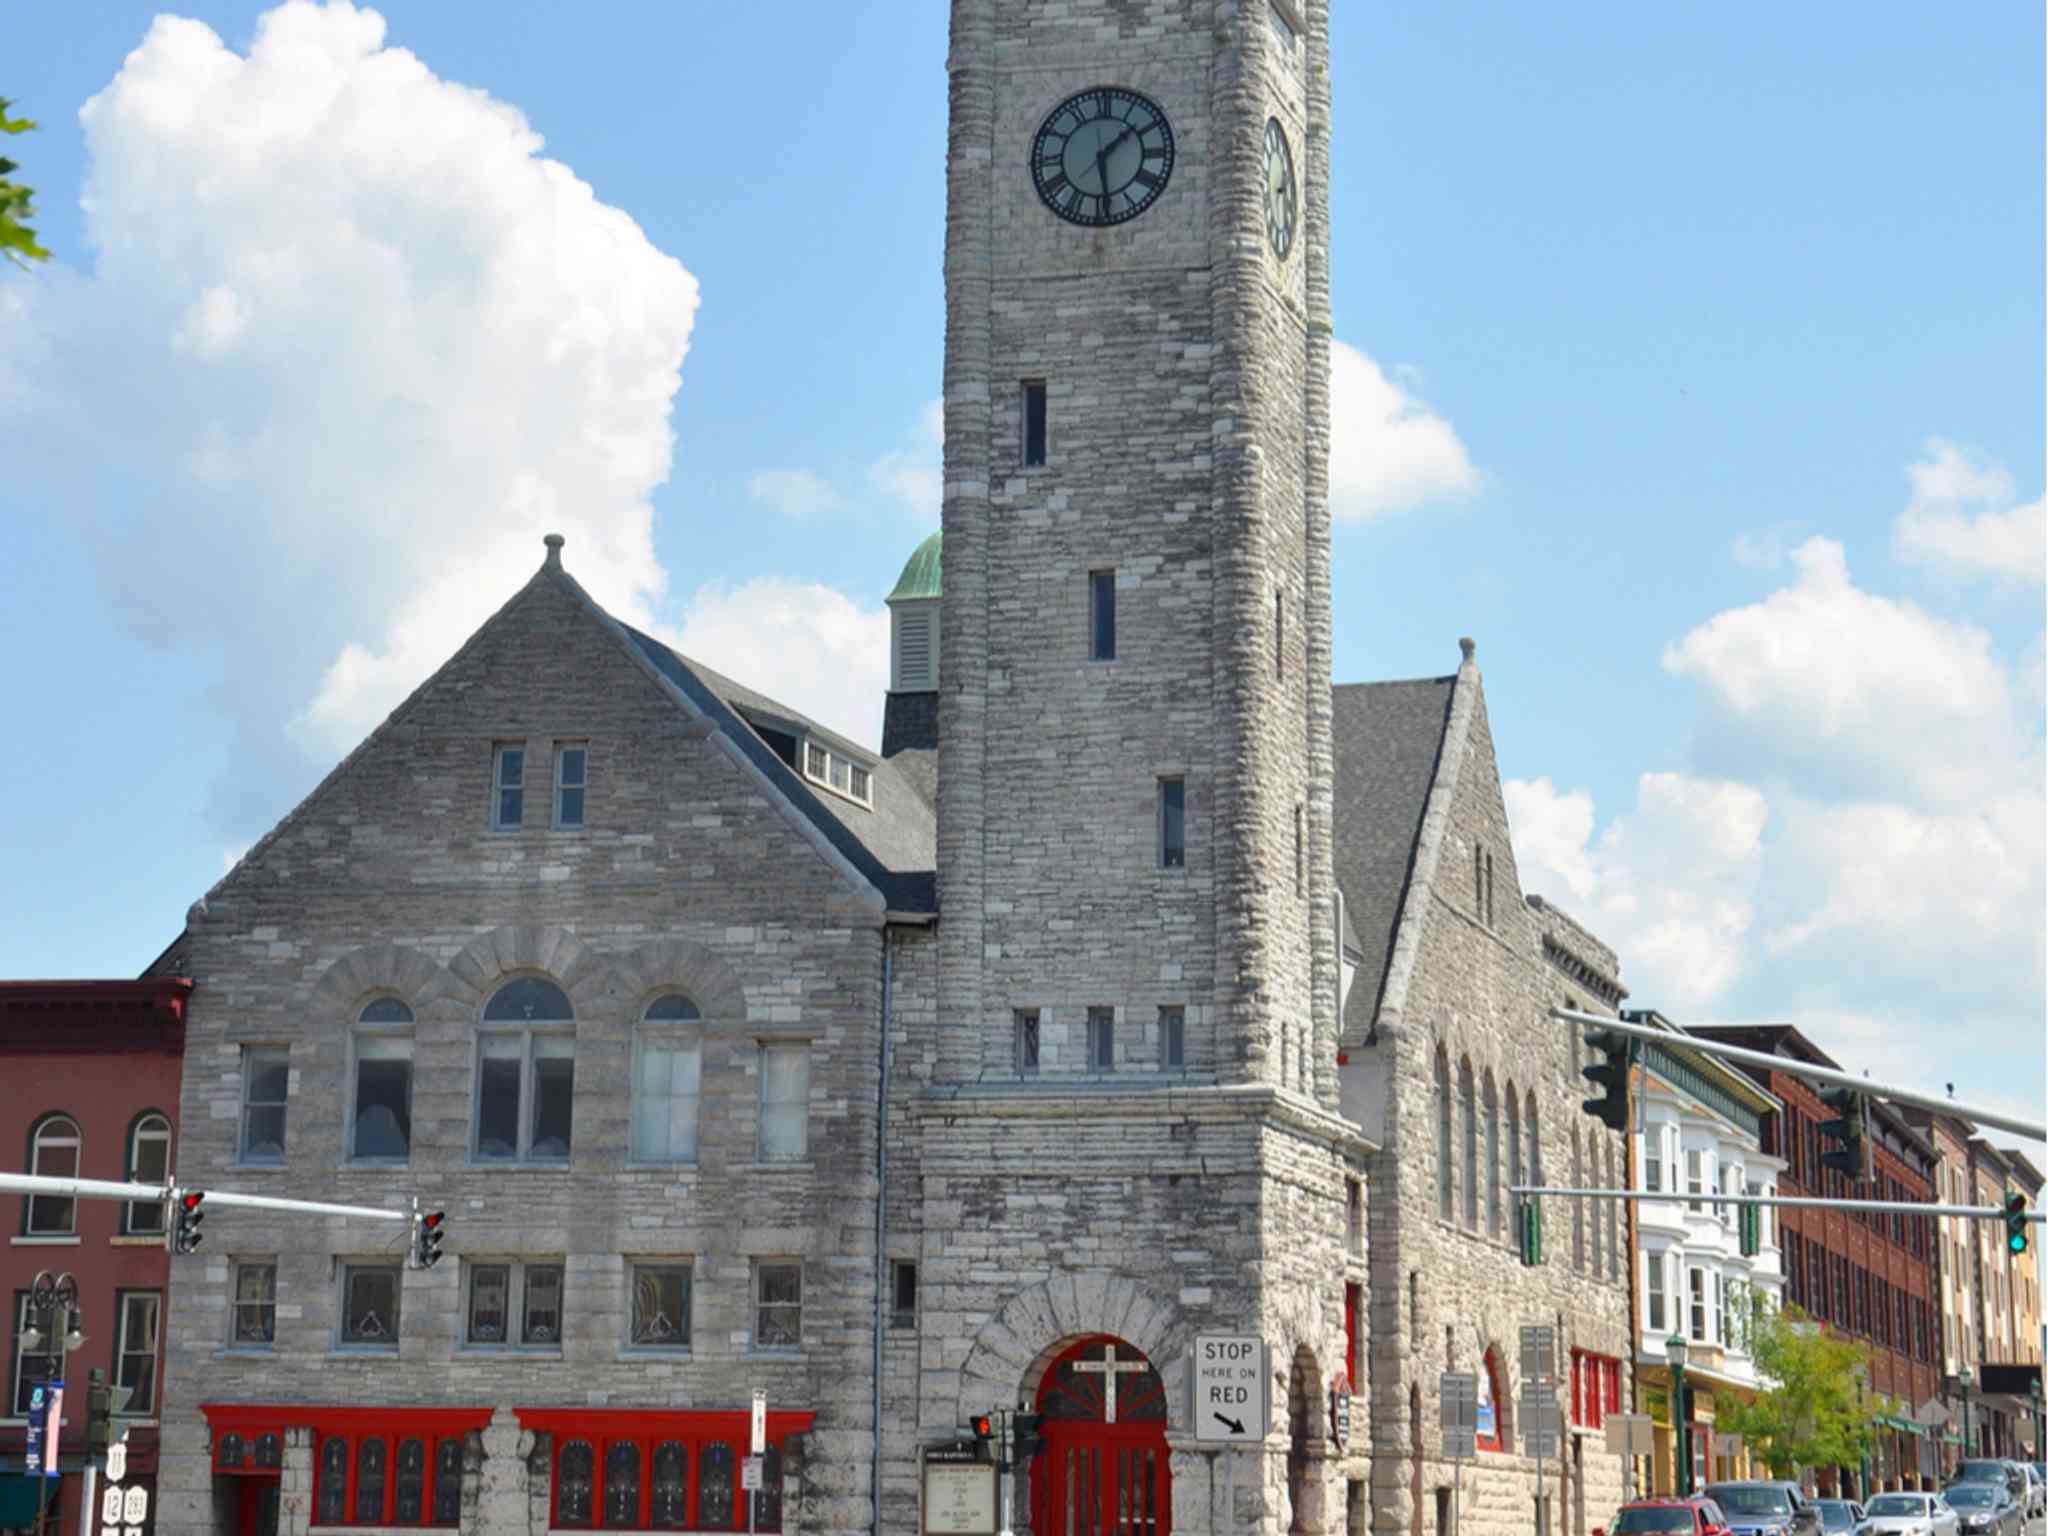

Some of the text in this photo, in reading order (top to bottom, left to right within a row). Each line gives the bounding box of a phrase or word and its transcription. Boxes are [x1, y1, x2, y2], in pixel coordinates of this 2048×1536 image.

[1205, 1342, 1253, 1360] STOP
[1202, 1368, 1256, 1379] HERE ON
[1210, 1386, 1248, 1403] RED
